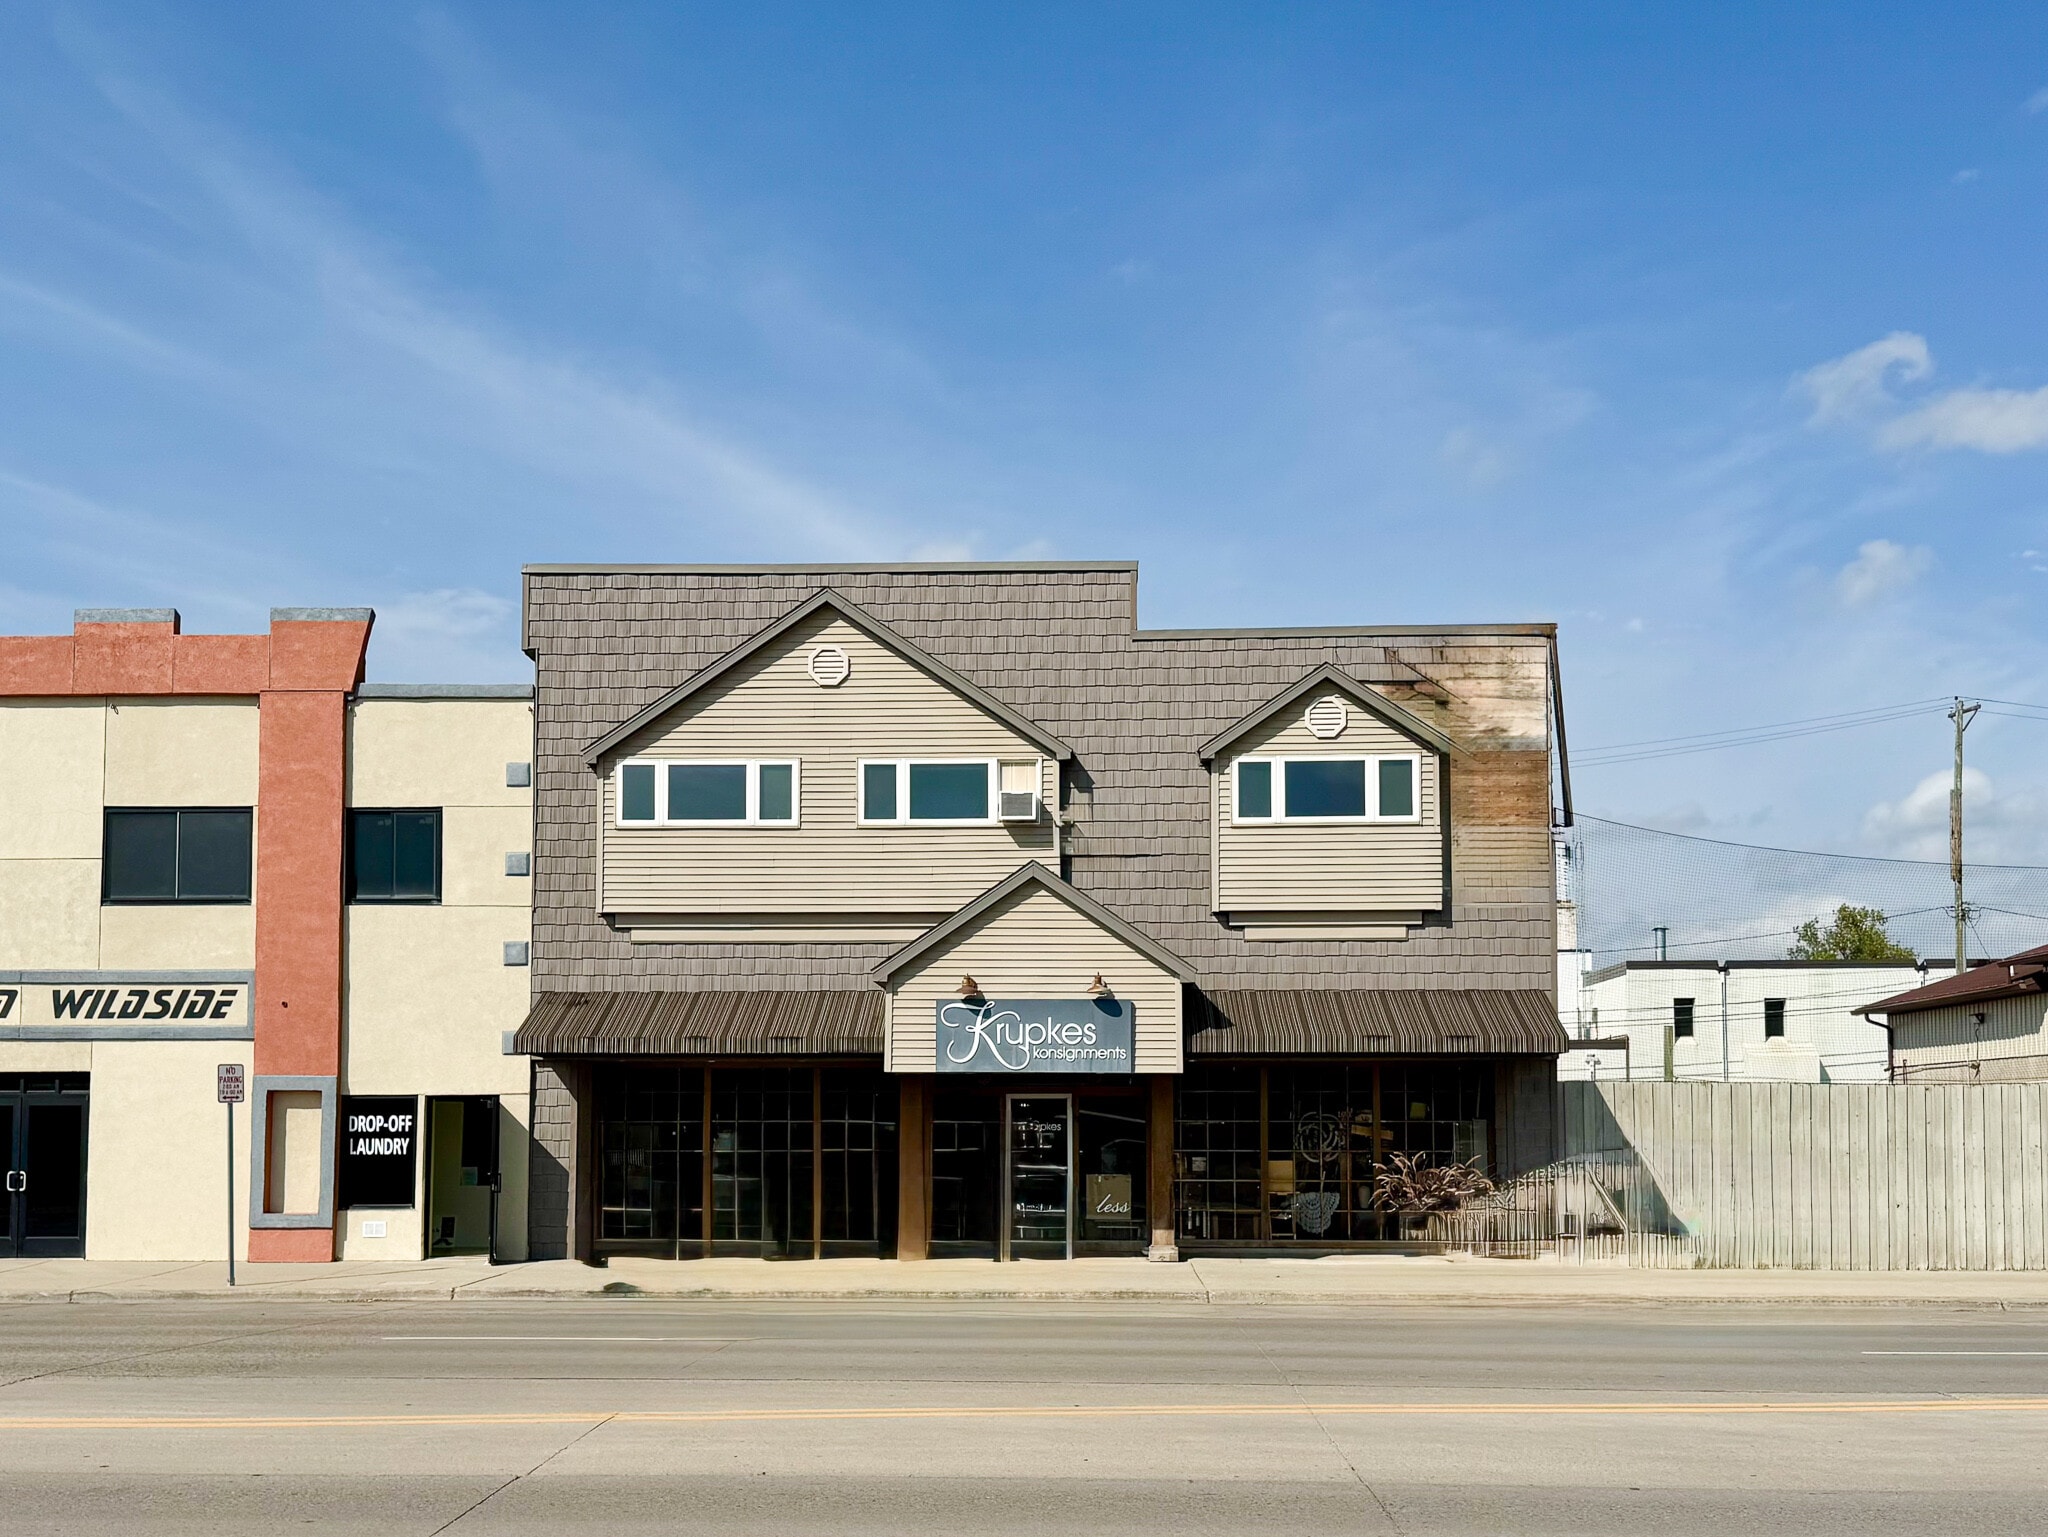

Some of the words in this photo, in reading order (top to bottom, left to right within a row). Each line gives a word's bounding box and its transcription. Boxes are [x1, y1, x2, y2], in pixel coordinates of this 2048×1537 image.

[52, 989, 239, 1019] WILDSIDE
[1032, 1045, 1127, 1062] konsignments
[225, 1066, 236, 1075] NO
[349, 1114, 413, 1133] DROP-OFF
[349, 1137, 410, 1156] LAUNDRY
[1095, 1193, 1131, 1213] less
